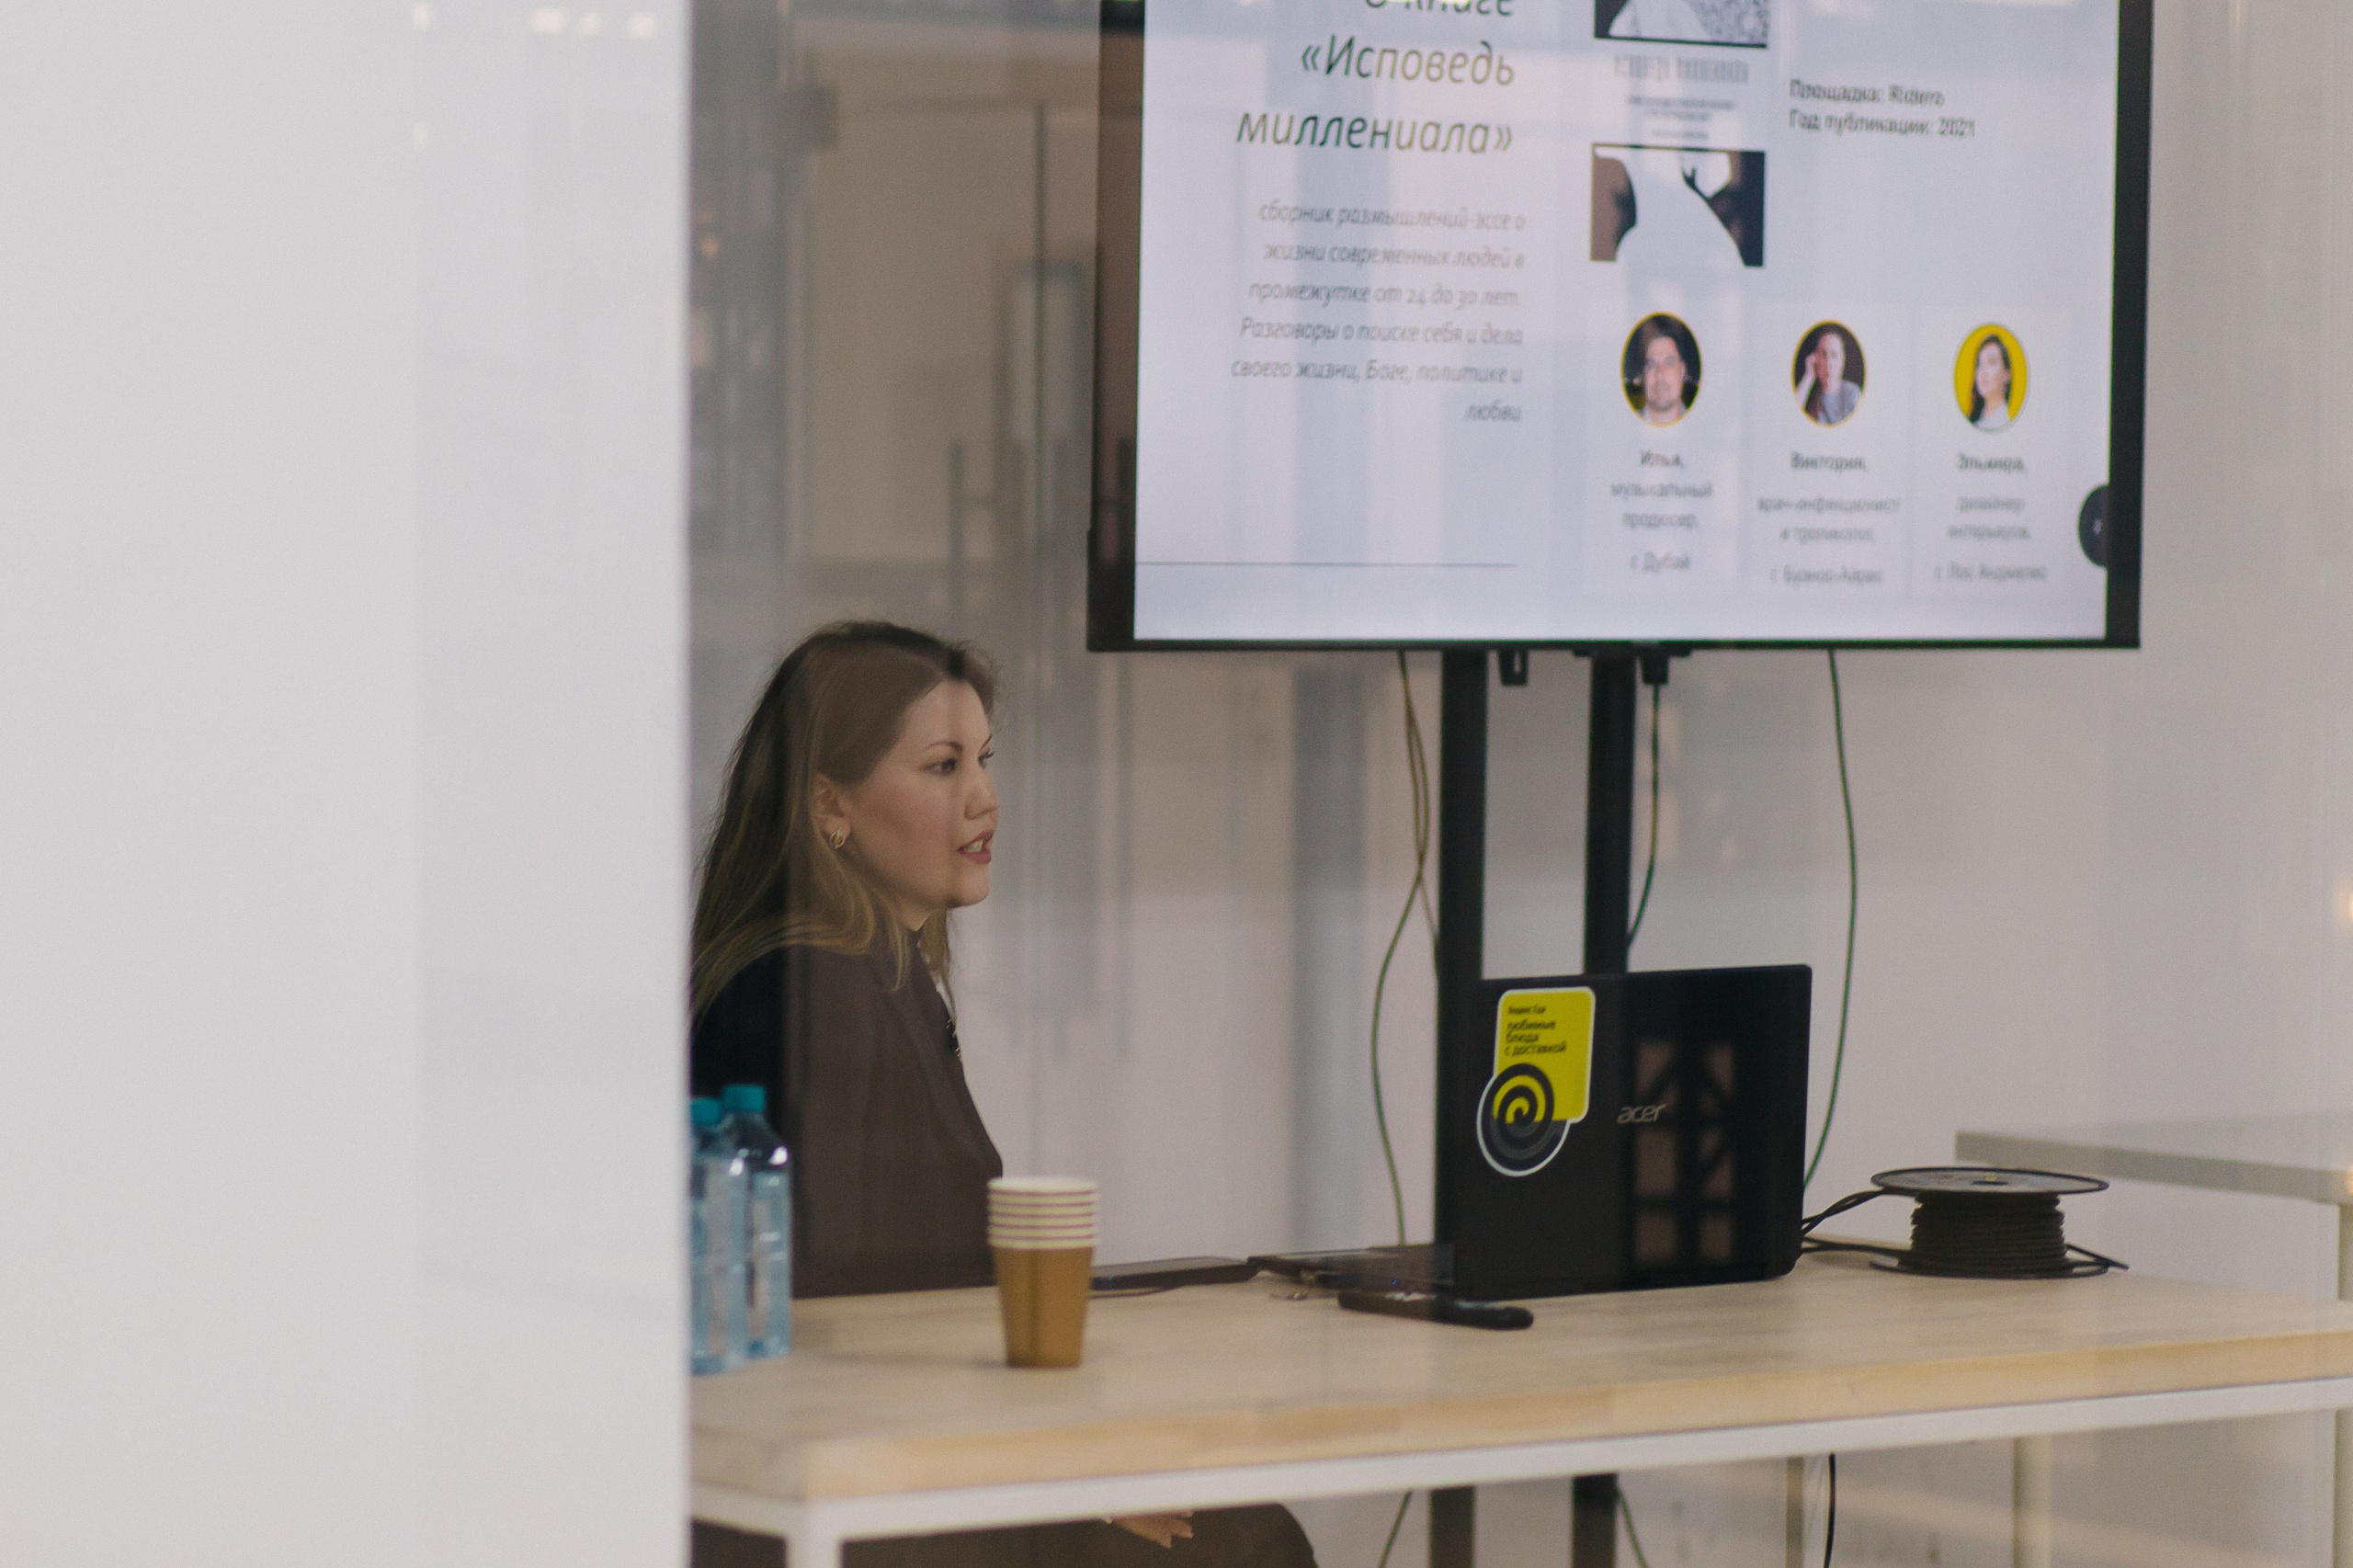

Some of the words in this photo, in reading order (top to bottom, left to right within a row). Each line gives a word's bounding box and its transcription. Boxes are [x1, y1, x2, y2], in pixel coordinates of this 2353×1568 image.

[1302, 35, 1515, 86] «Исповедь
[1236, 111, 1513, 154] миллениала»
[1789, 108, 1821, 131] Год
[1937, 115, 1975, 138] 2021
[1258, 199, 1334, 227] сборник
[1328, 244, 1450, 268] современных
[1452, 244, 1510, 269] людей
[1248, 282, 1370, 307] промежутке
[1373, 287, 1403, 303] от
[1240, 315, 1339, 346] Разговоры
[1357, 324, 1419, 343] поиске
[1422, 321, 1462, 345] себя
[1462, 398, 1522, 422] любви
[1617, 1103, 1666, 1125] acer
